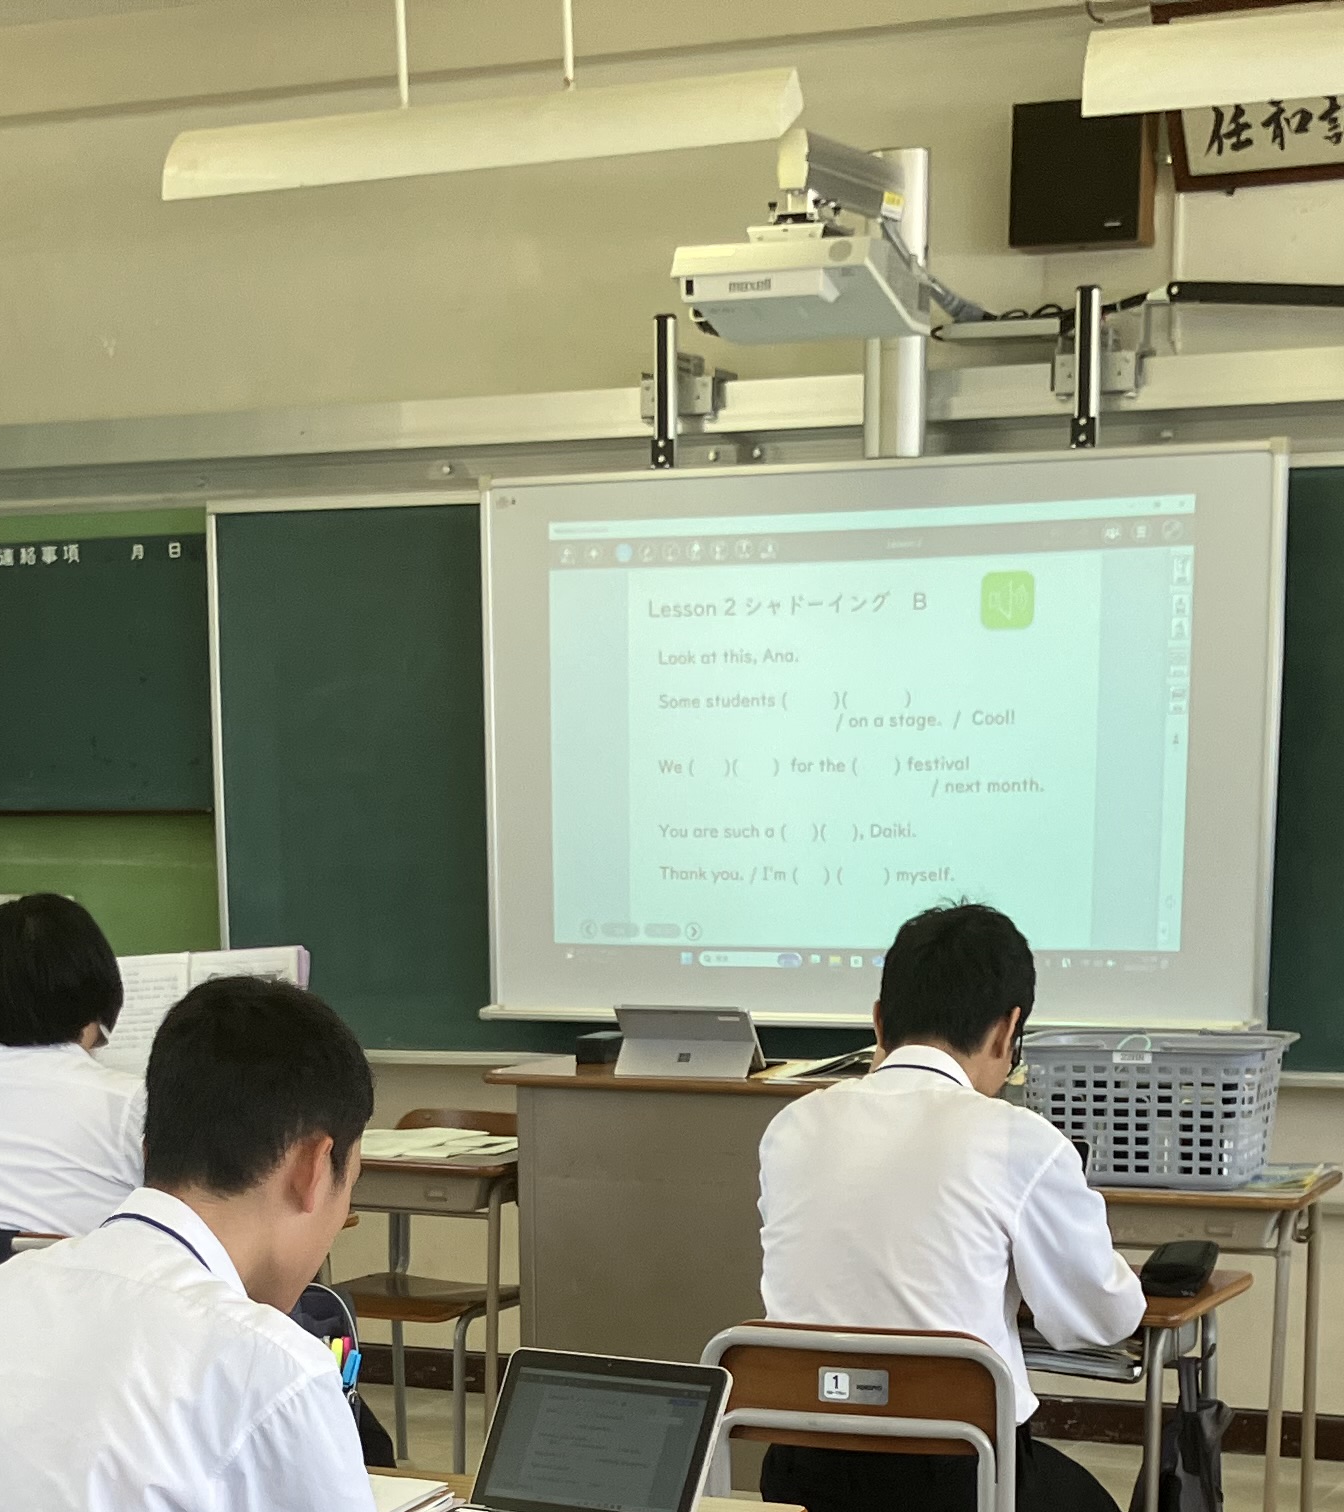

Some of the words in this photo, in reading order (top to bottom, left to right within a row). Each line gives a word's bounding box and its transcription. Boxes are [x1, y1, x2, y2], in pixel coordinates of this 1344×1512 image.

[647, 599, 717, 618] Lesson
[723, 598, 737, 616] 2
[745, 590, 891, 616] シャドーイング
[912, 592, 927, 611] B
[658, 648, 696, 666] Look
[700, 650, 717, 665] at
[658, 694, 701, 710] Some
[705, 693, 776, 710] students
[848, 716, 869, 729] on
[873, 716, 884, 729] a
[971, 708, 1016, 726] Cool!
[658, 759, 683, 775] We
[790, 757, 814, 773] for
[819, 757, 846, 773] the
[906, 755, 970, 772] festival
[944, 779, 981, 794] next
[987, 777, 1045, 794] month.
[658, 824, 689, 840] You
[693, 826, 719, 839] are
[724, 824, 761, 839] such
[765, 827, 775, 839] a
[869, 823, 917, 839] Daiki.
[660, 866, 707, 881] Thank
[711, 869, 745, 884] you.
[896, 867, 956, 885] myself.
[832, 1374, 839, 1390] 1
